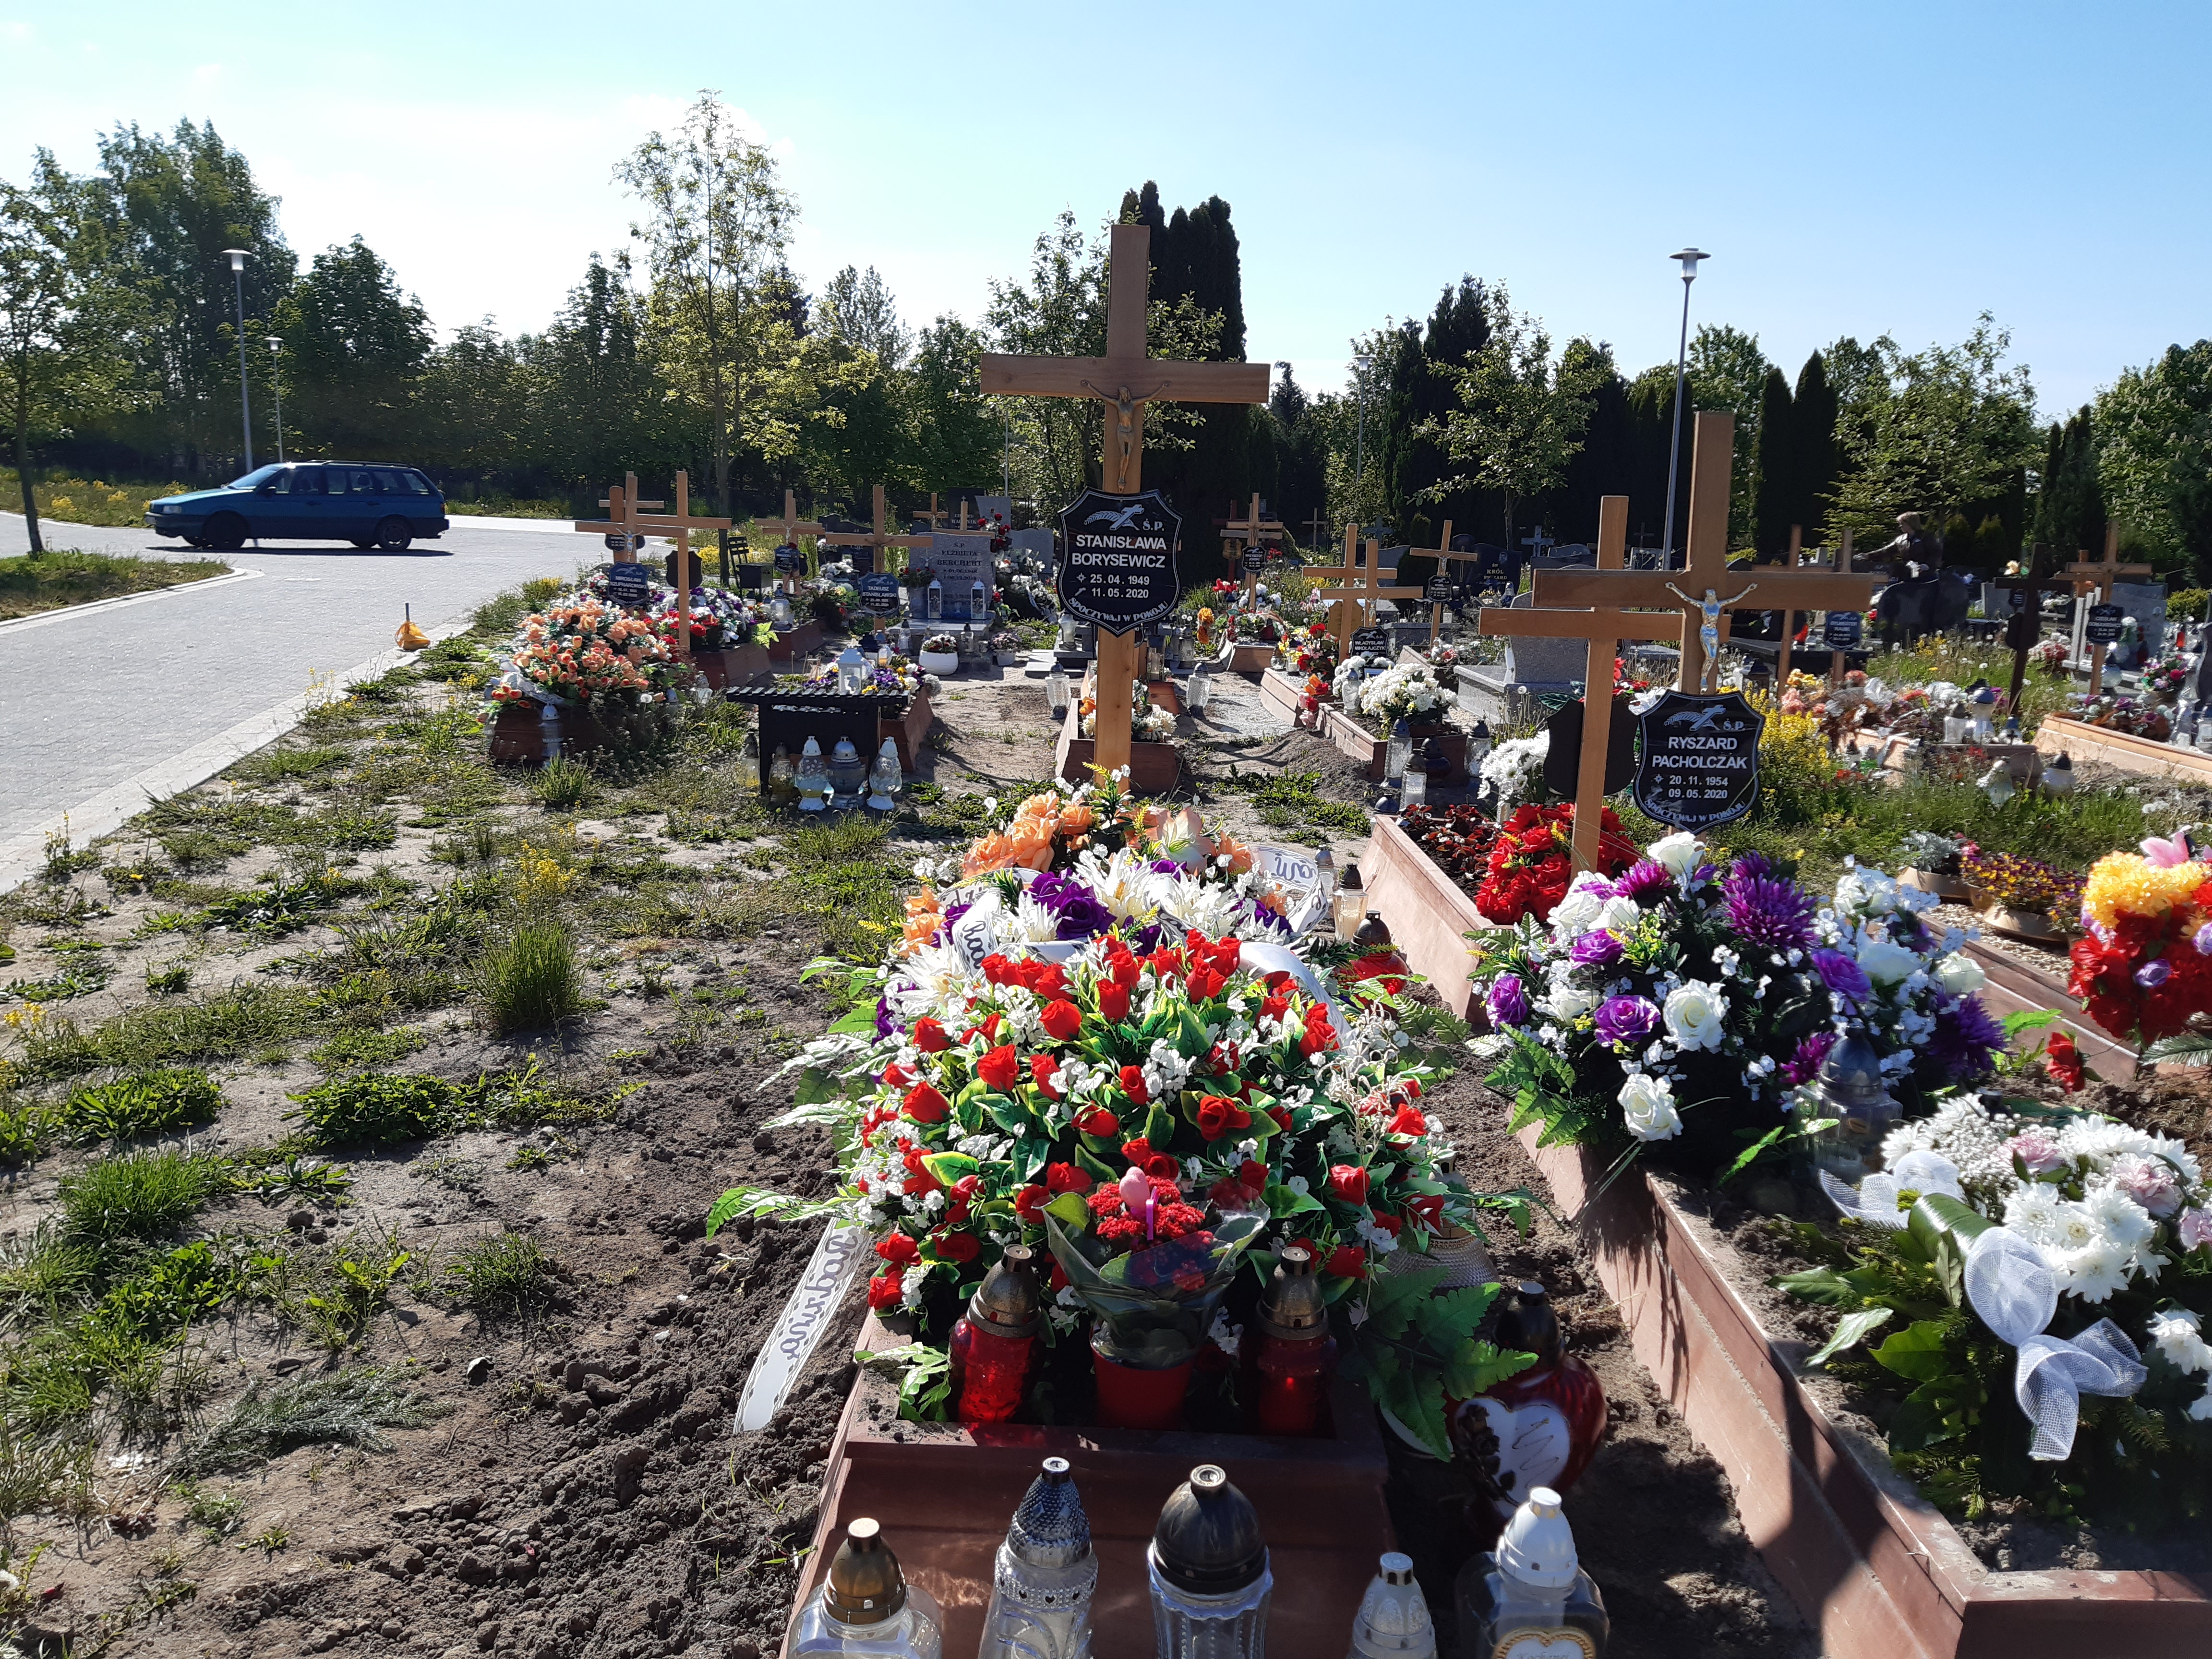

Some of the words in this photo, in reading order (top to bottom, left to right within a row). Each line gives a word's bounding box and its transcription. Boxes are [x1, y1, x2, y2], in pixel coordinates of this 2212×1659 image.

[1142, 518, 1165, 531] Ś.P.
[1076, 535, 1167, 550] STANISŁAWA
[1072, 553, 1166, 568] BORYSEWICZ
[1068, 597, 1121, 622] SPOCZYWAJ
[1123, 614, 1131, 622] W
[1133, 600, 1168, 621] POKOJU
[1723, 718, 1746, 731] Ś.P.
[1668, 736, 1738, 750] RYSZARD
[1652, 755, 1748, 769] PACHOLCZAK
[1644, 798, 1696, 822] SPOCZYWAJ
[1709, 800, 1746, 821] POKOJU
